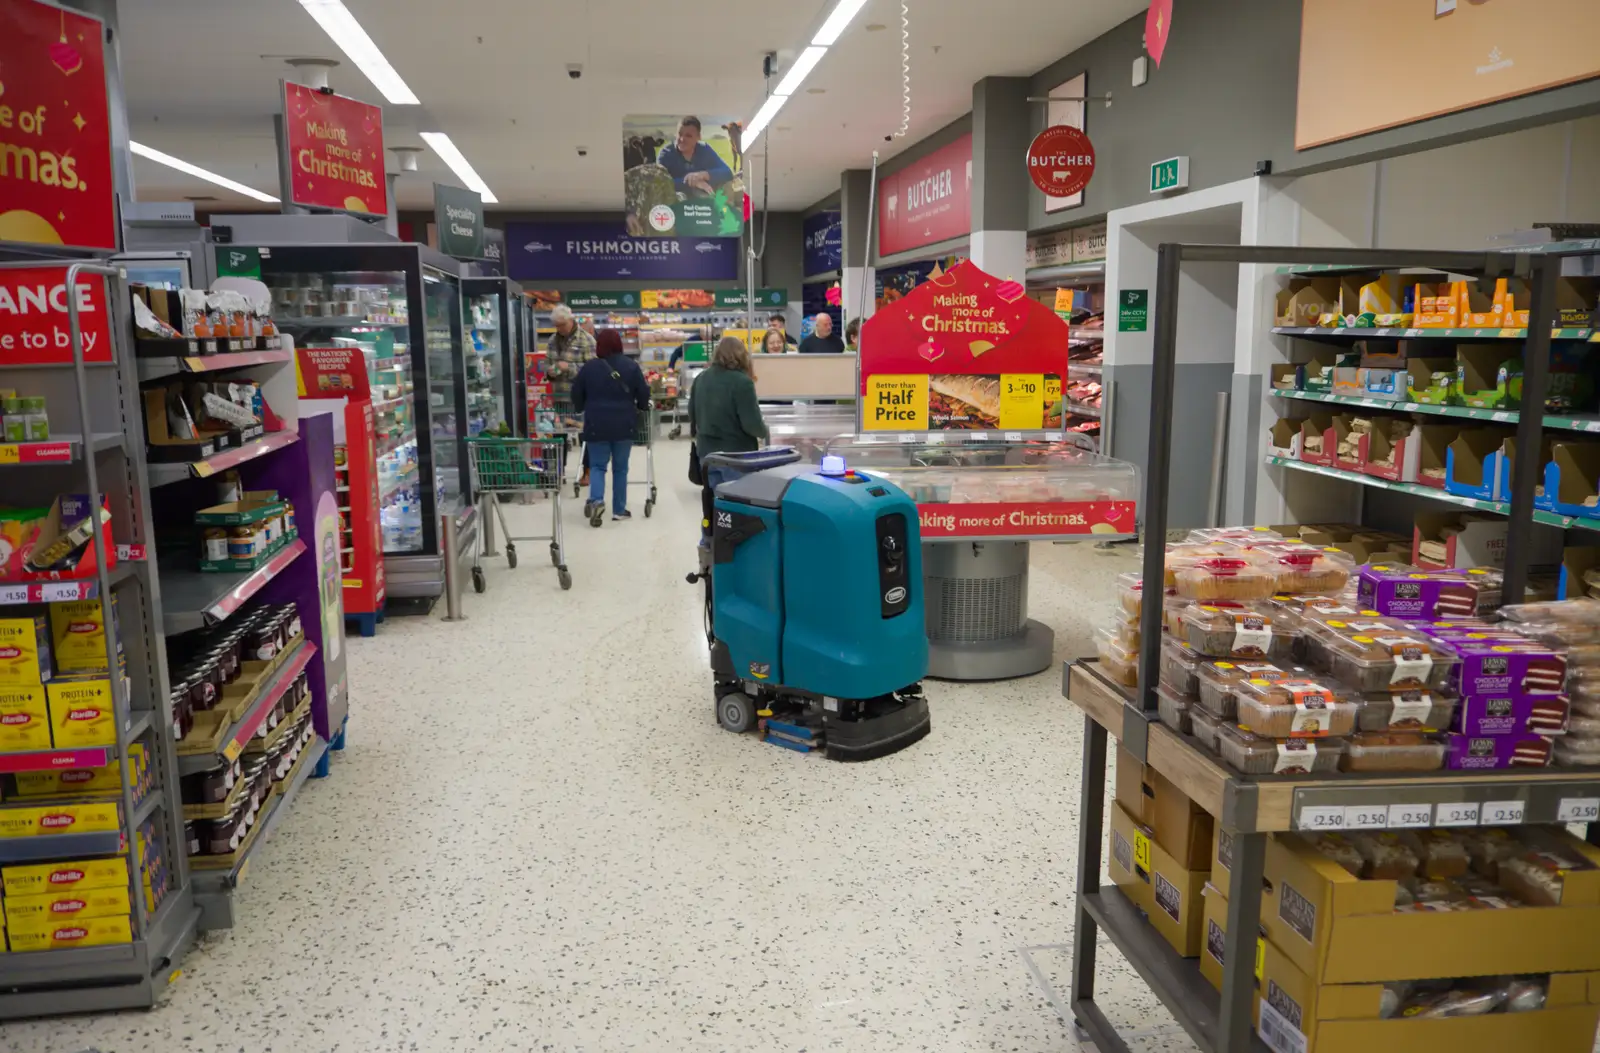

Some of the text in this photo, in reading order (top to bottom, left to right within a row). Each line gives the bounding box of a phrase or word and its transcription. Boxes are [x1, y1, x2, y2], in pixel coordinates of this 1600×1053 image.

[19, 105, 47, 136] of
[306, 121, 348, 146] Making
[326, 144, 362, 163] more of
[1031, 155, 1093, 167] BUTCHER
[299, 148, 377, 188] Christmas.
[907, 168, 952, 211] BUTCHER
[451, 223, 473, 237] Cheese
[566, 241, 680, 254] FISHMONGER
[933, 293, 978, 308] Making
[952, 307, 995, 318] more of
[922, 313, 1010, 334] Christmas.
[21, 331, 47, 348] to
[1007, 383, 1013, 394] 3
[1021, 383, 1036, 394] £10
[879, 390, 914, 405] Half
[875, 406, 916, 421] Price
[717, 511, 732, 523] X4
[959, 517, 990, 527] more
[992, 514, 1006, 526] of
[1009, 510, 1088, 526] Christmas.
[5, 592, 26, 600] £1.50
[57, 589, 77, 598] £1.50
[70, 709, 98, 720] Barilla
[1401, 812, 1430, 824] £2.50
[1451, 810, 1477, 820] £2.50
[1495, 810, 1523, 820] £2.50
[1572, 807, 1598, 817] £2.50
[42, 816, 73, 827] Barilla
[1314, 815, 1343, 826] £2.50
[1357, 813, 1386, 825] £2.50
[1135, 836, 1148, 865] £1
[51, 871, 83, 882] Barilla
[53, 901, 83, 912] Barilla
[55, 930, 86, 941] Barilla
